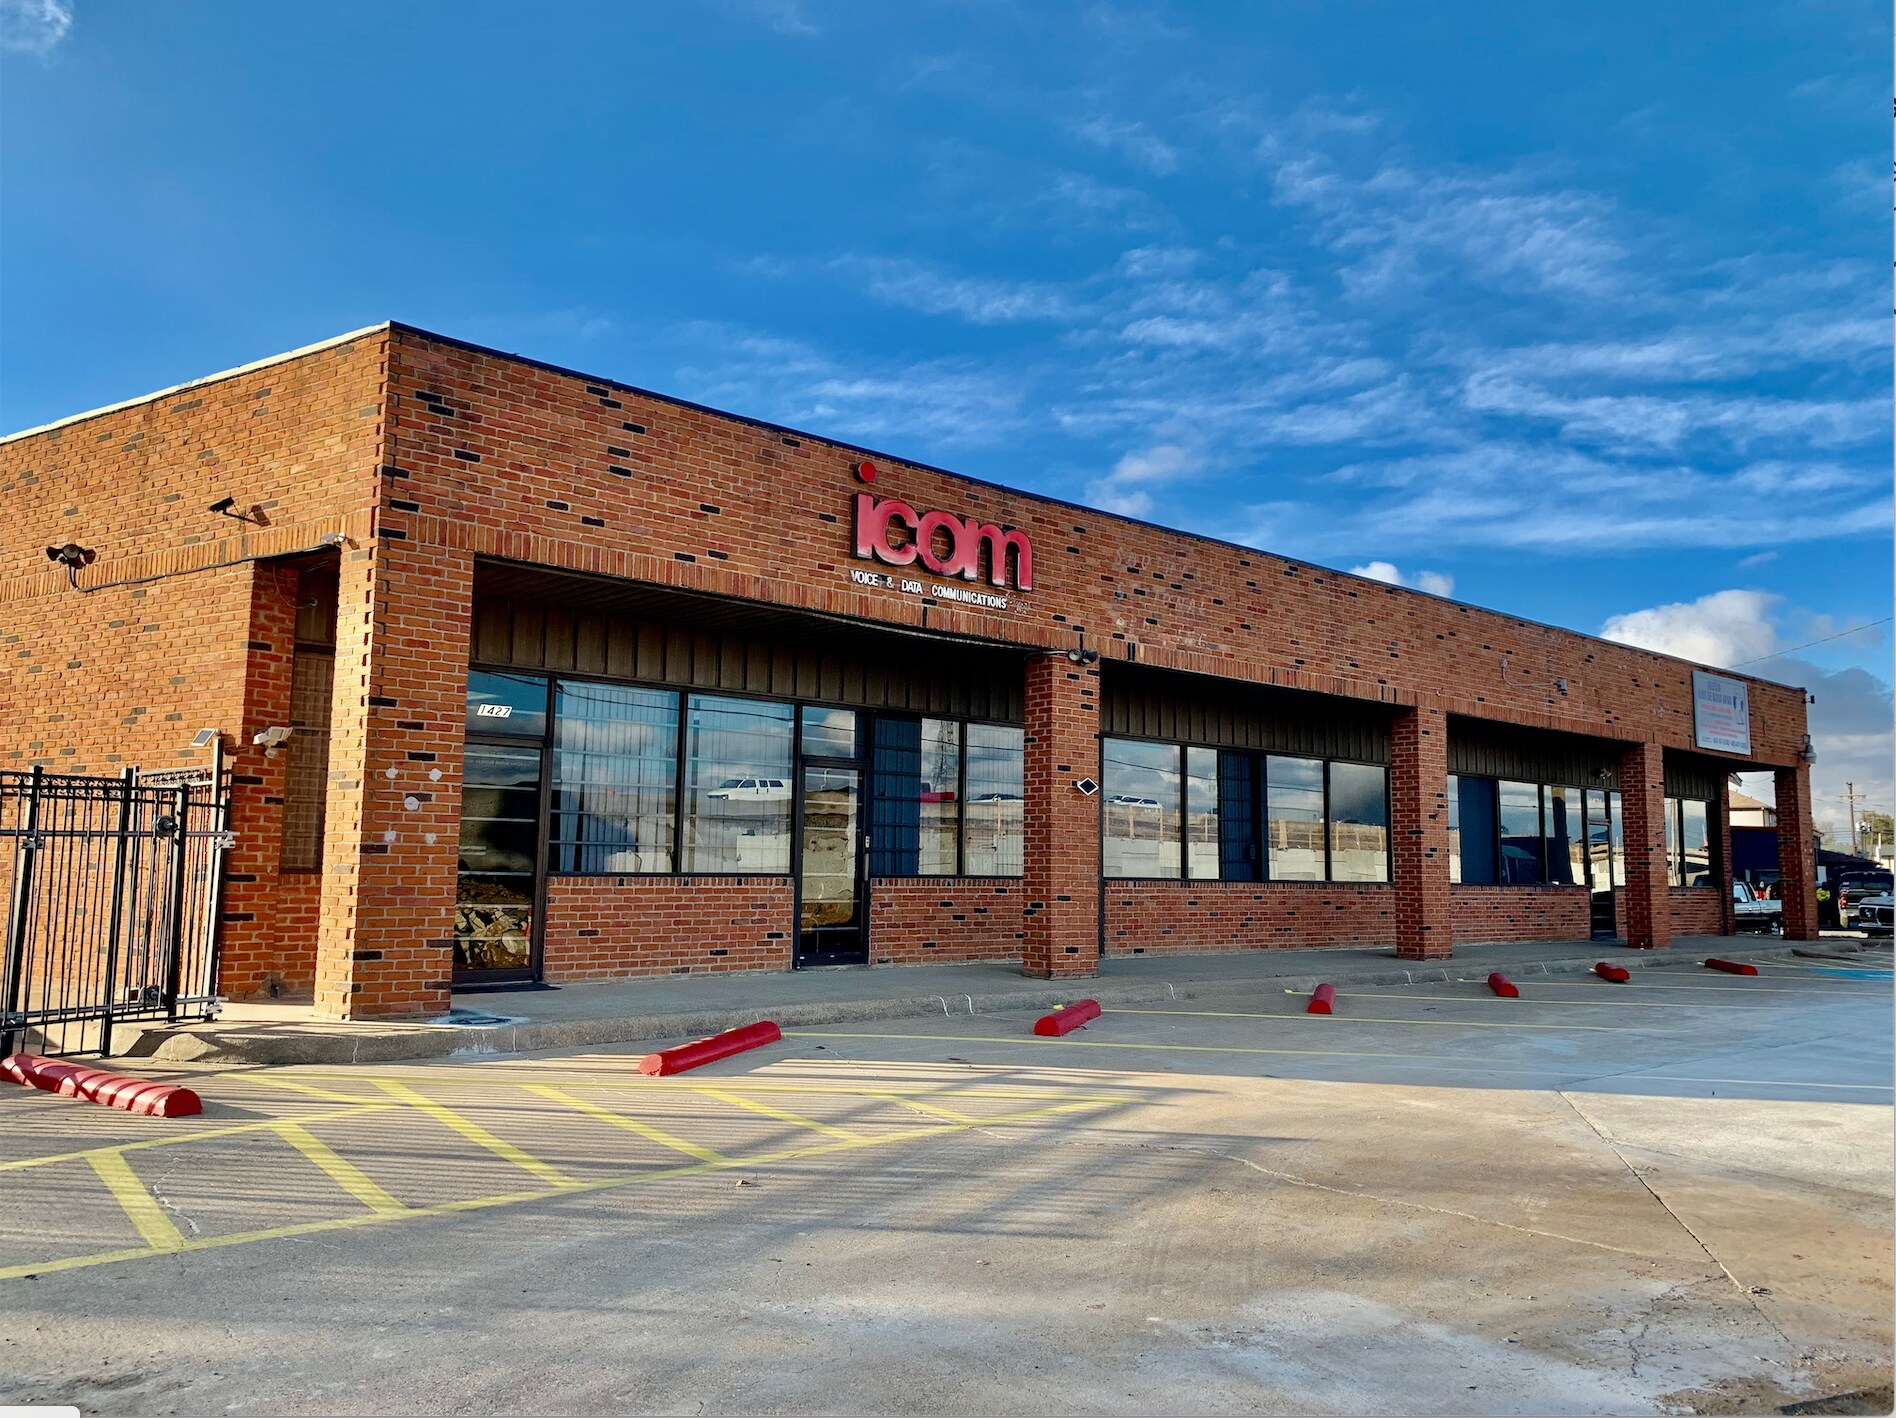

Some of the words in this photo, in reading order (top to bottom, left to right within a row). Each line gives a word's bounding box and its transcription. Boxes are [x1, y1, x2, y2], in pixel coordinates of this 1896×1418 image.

[852, 461, 1033, 592] icom
[849, 569, 879, 587] VOICE
[886, 576, 895, 589] &
[901, 579, 924, 595] DATA
[931, 584, 1008, 610] COMMUNICATIONS
[480, 705, 511, 717] 1427
